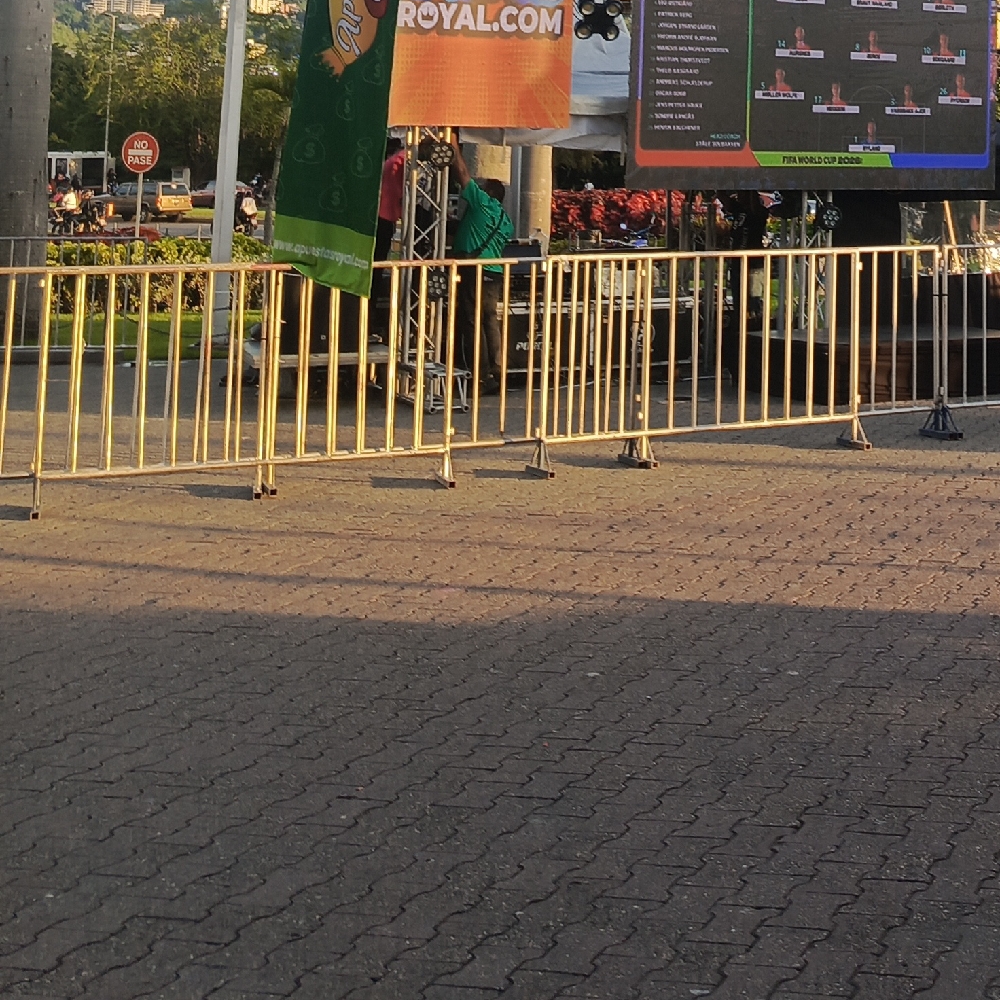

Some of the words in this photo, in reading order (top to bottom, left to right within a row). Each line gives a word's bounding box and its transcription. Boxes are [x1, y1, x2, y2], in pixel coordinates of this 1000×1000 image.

[397, 0, 563, 35] ROYAL.COM
[133, 139, 149, 149] NO
[127, 156, 152, 165] PASE
[782, 155, 797, 164] FIFA
[798, 155, 823, 164] WORLD
[824, 156, 837, 164] CUP
